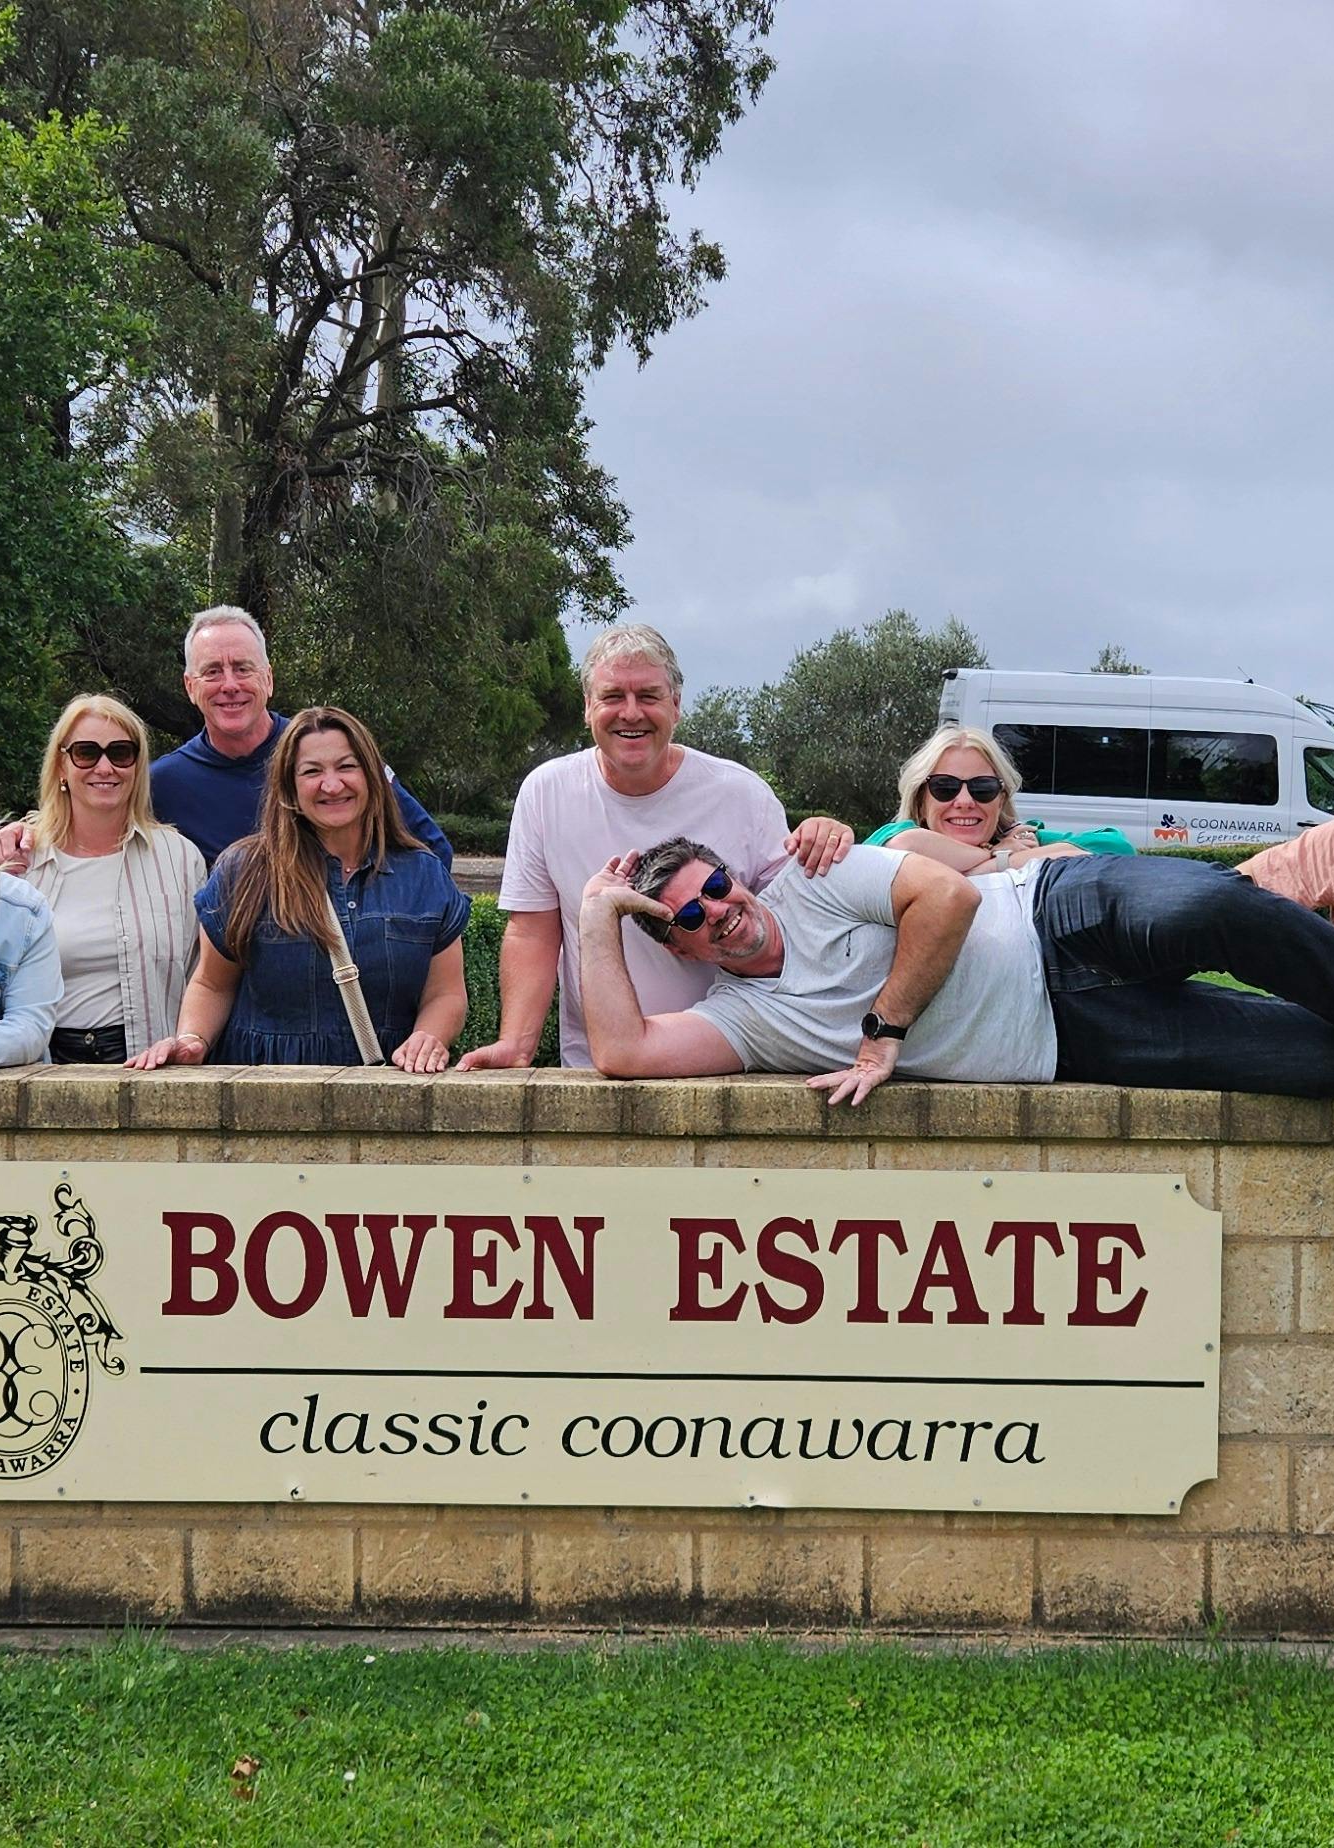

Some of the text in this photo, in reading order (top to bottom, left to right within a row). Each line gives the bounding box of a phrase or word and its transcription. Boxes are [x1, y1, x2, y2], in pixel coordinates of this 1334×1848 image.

[1190, 818, 1282, 833] COONAWARRA
[1196, 831, 1264, 845] Experiences
[162, 1211, 1150, 1329] BOWEN ESTATE
[25, 1286, 85, 1374] ESTATE
[259, 1394, 1047, 1466] classic coonawarra
